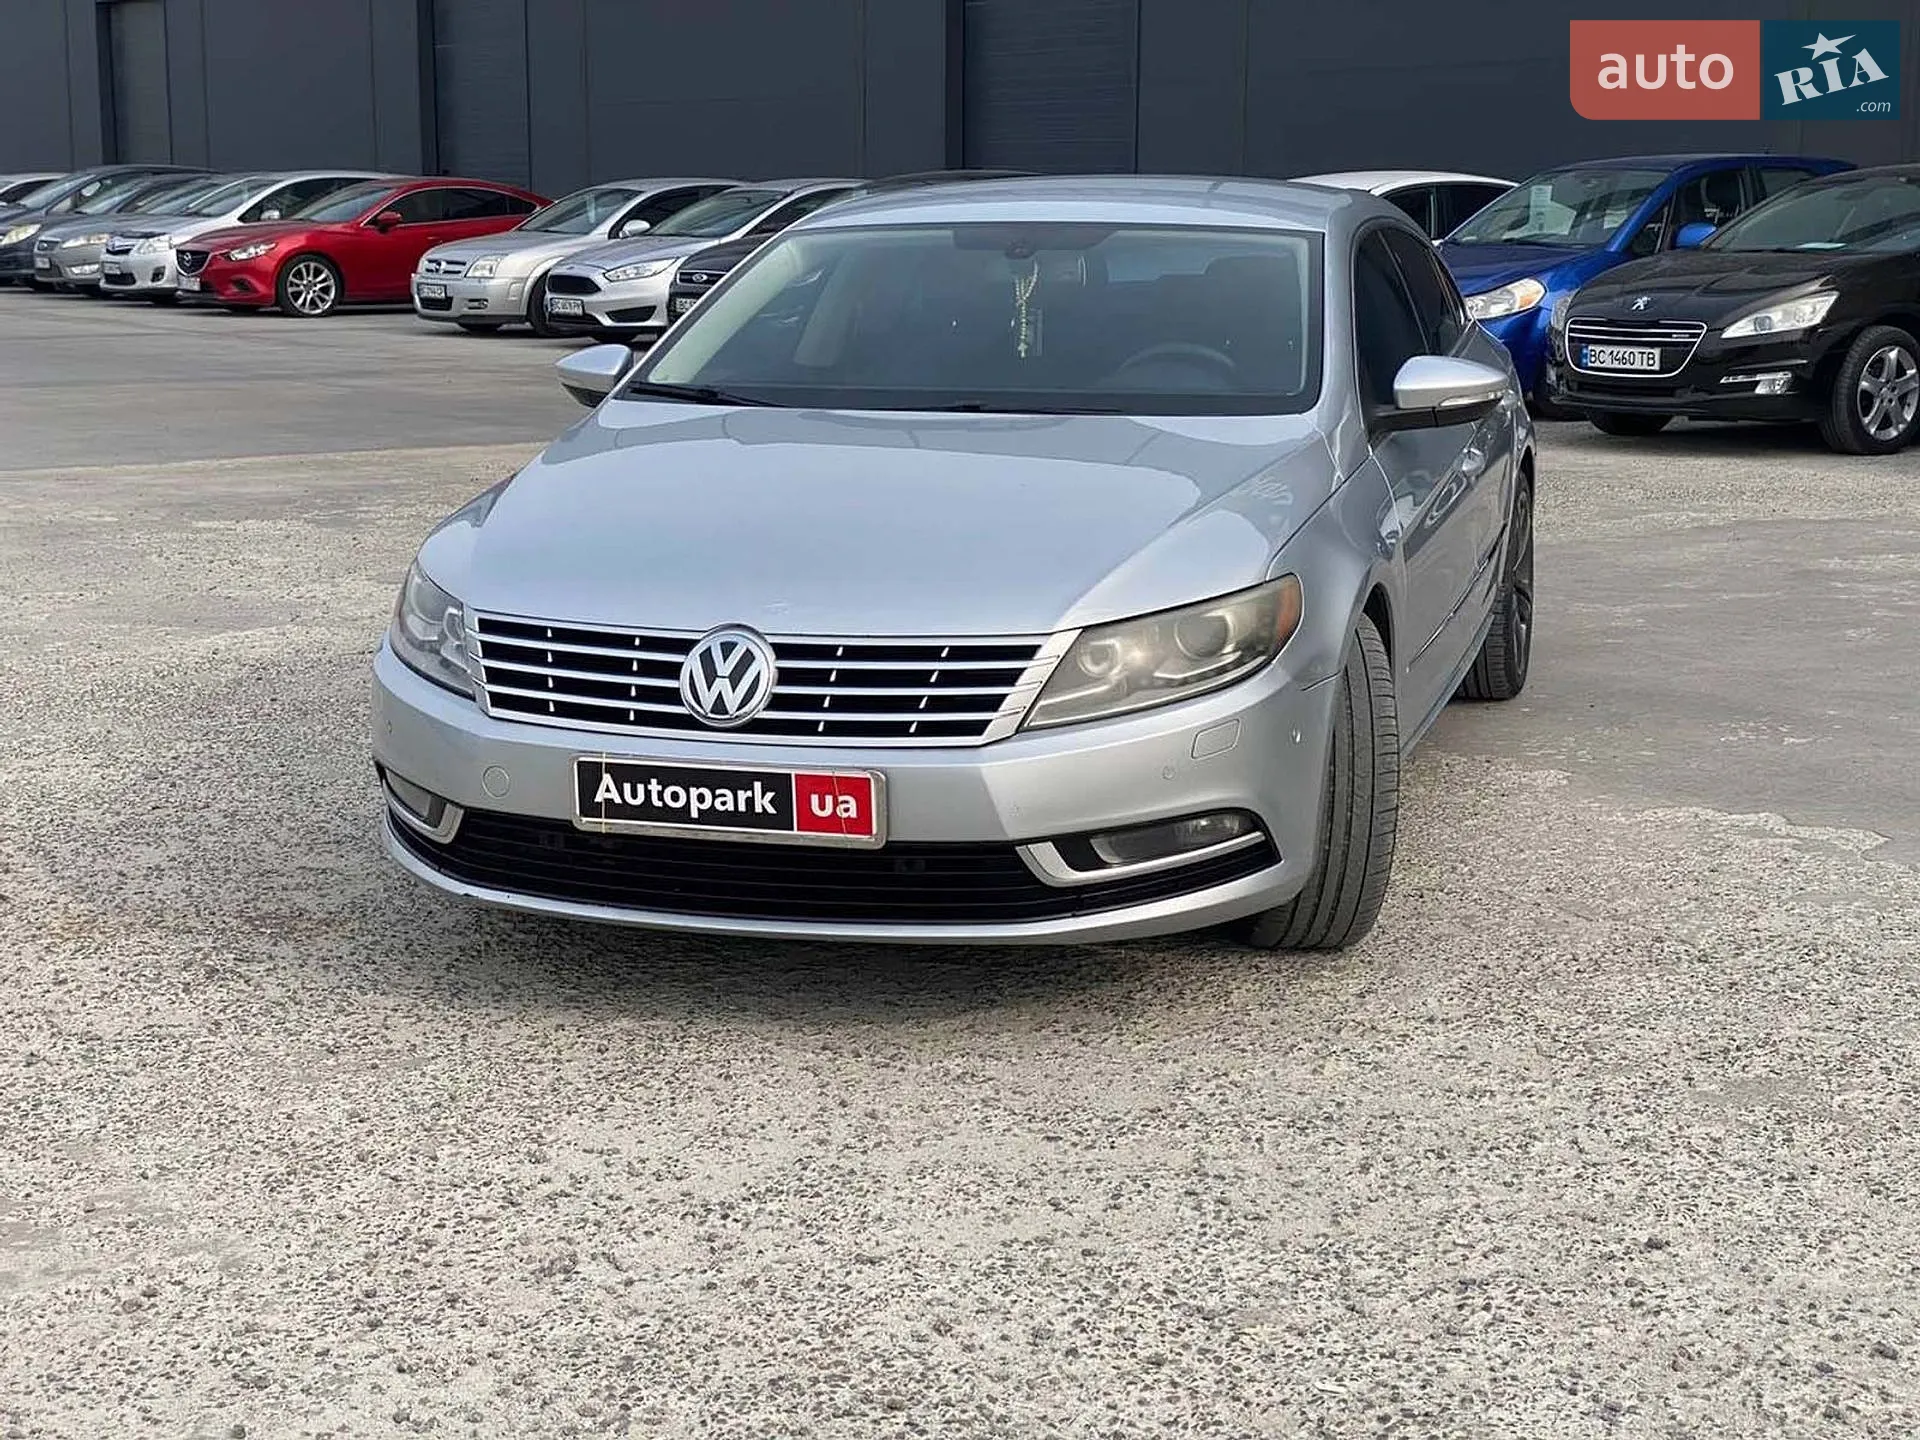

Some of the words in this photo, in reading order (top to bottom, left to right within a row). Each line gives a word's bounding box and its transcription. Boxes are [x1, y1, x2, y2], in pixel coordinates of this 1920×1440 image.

[1589, 348, 1606, 365] BC
[1608, 349, 1636, 367] 1460
[1637, 351, 1656, 368] TB
[593, 772, 778, 819] Autopark
[809, 792, 858, 819] ua
